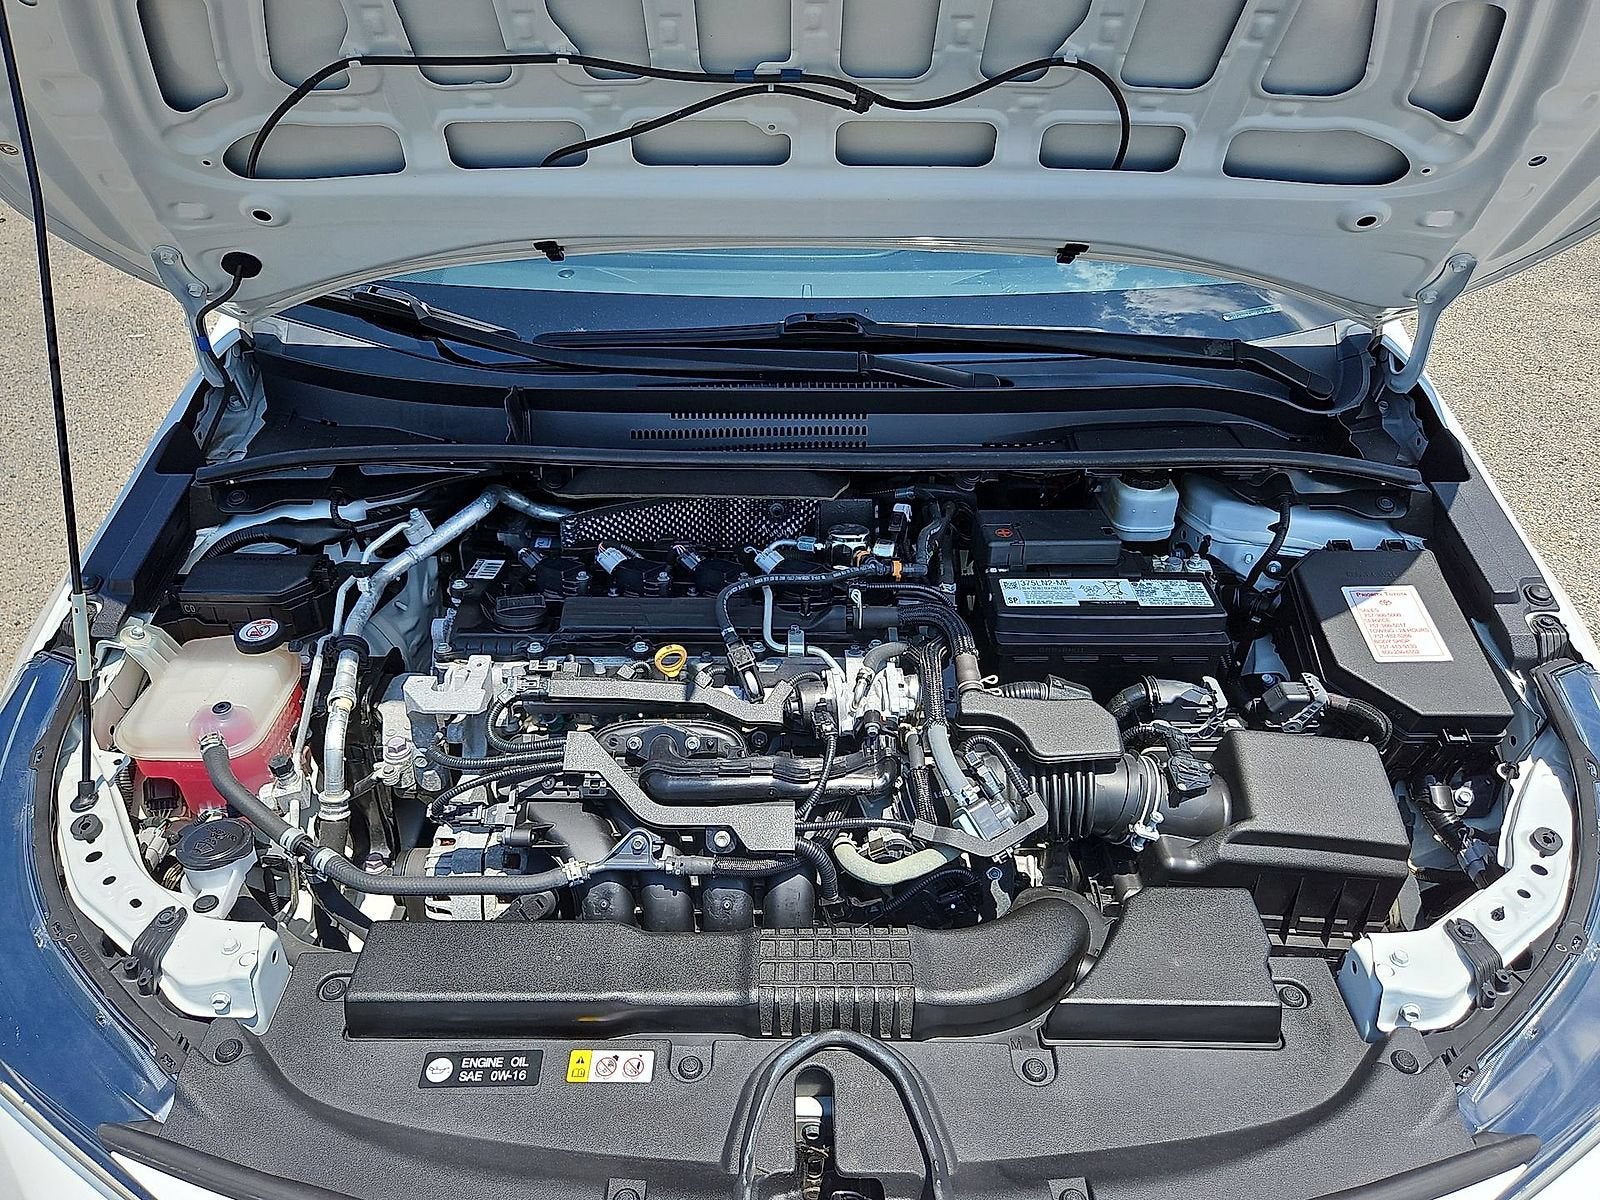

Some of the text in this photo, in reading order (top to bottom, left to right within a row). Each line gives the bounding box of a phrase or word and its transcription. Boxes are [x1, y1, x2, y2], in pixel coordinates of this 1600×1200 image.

[461, 1055, 529, 1068] ENGINE OIL
[458, 1069, 527, 1082] SAE 0W-16
